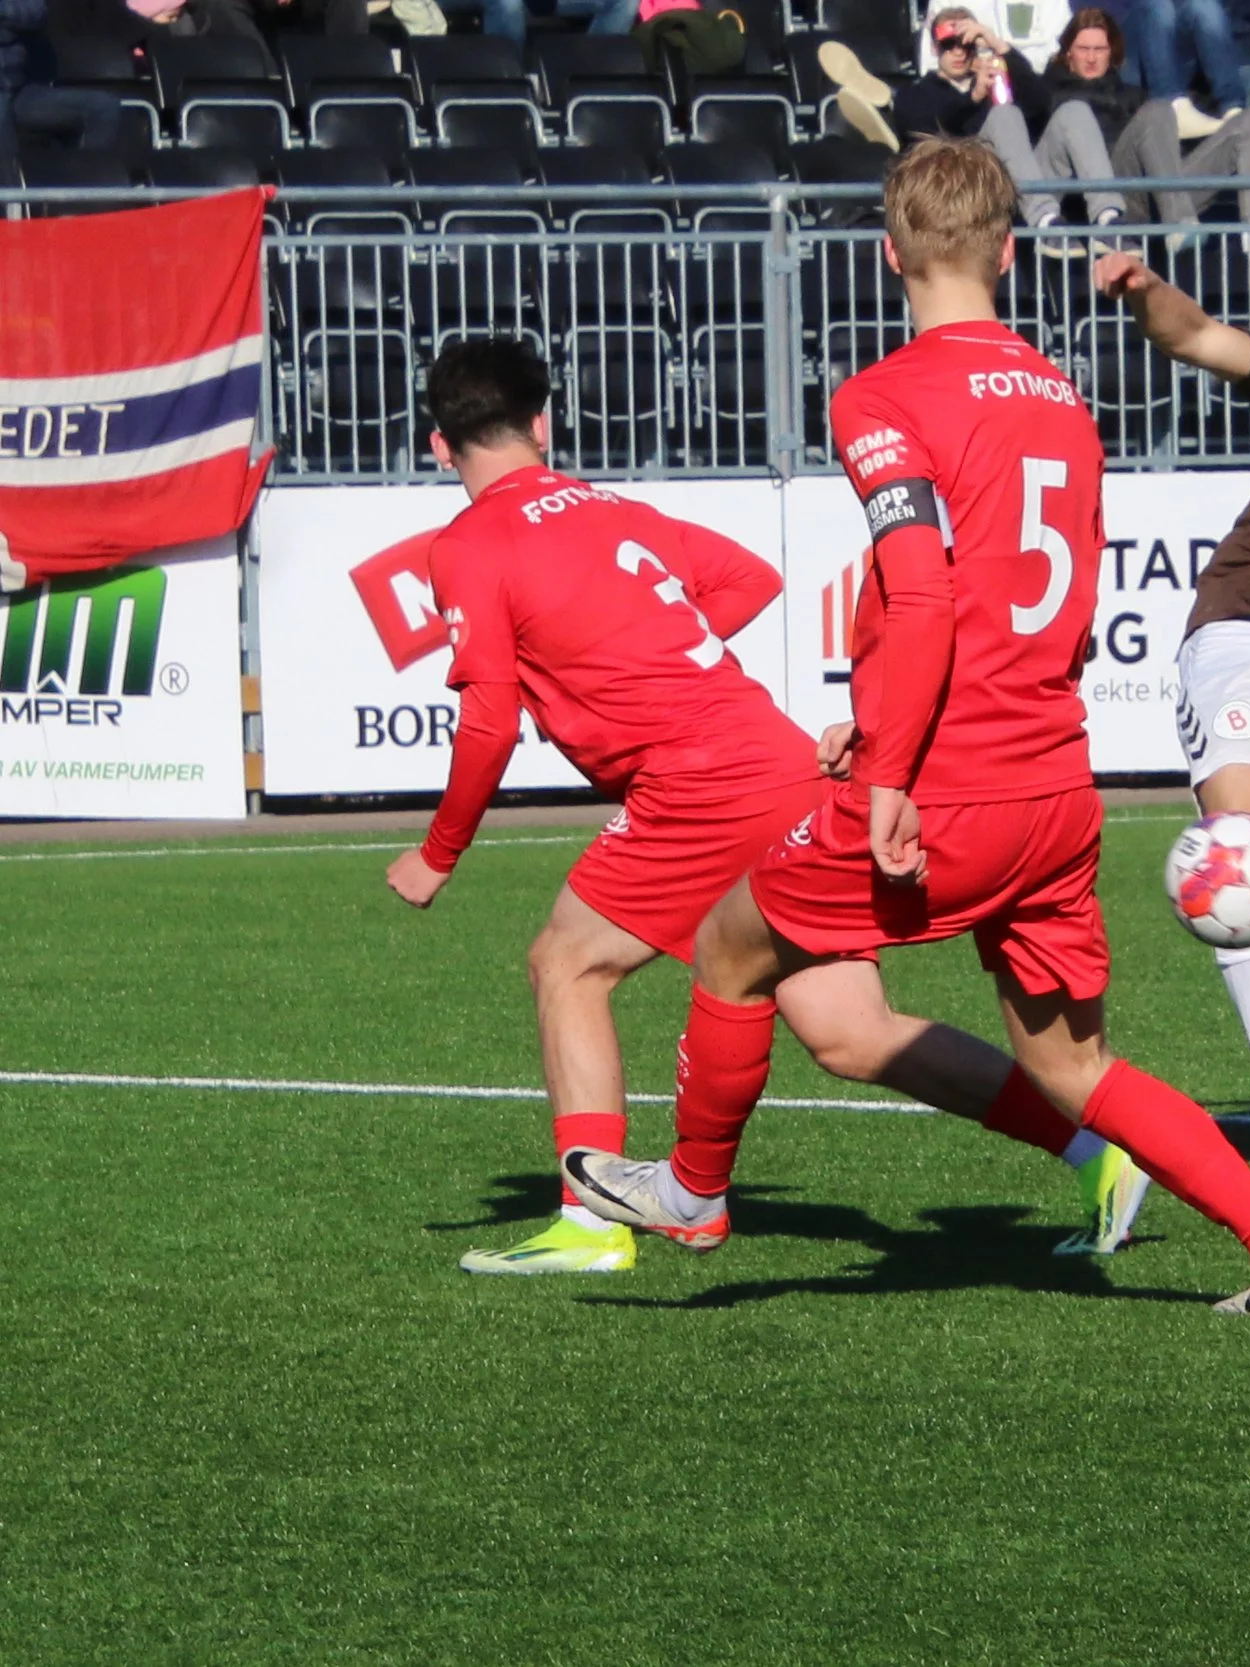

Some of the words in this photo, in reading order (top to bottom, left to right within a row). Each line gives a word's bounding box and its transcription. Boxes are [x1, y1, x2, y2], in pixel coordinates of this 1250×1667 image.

[969, 371, 1077, 407] FOTMOB
[0, 403, 125, 457] EDET
[846, 428, 905, 463] REMA
[857, 448, 898, 479] 1000
[866, 486, 910, 521] OPP
[1010, 456, 1074, 636] 5
[616, 540, 725, 670] 3
[1093, 677, 1150, 702] ekte
[1227, 710, 1247, 731] B
[10, 761, 37, 777] AV
[43, 761, 204, 781] VARMEPUMPER
